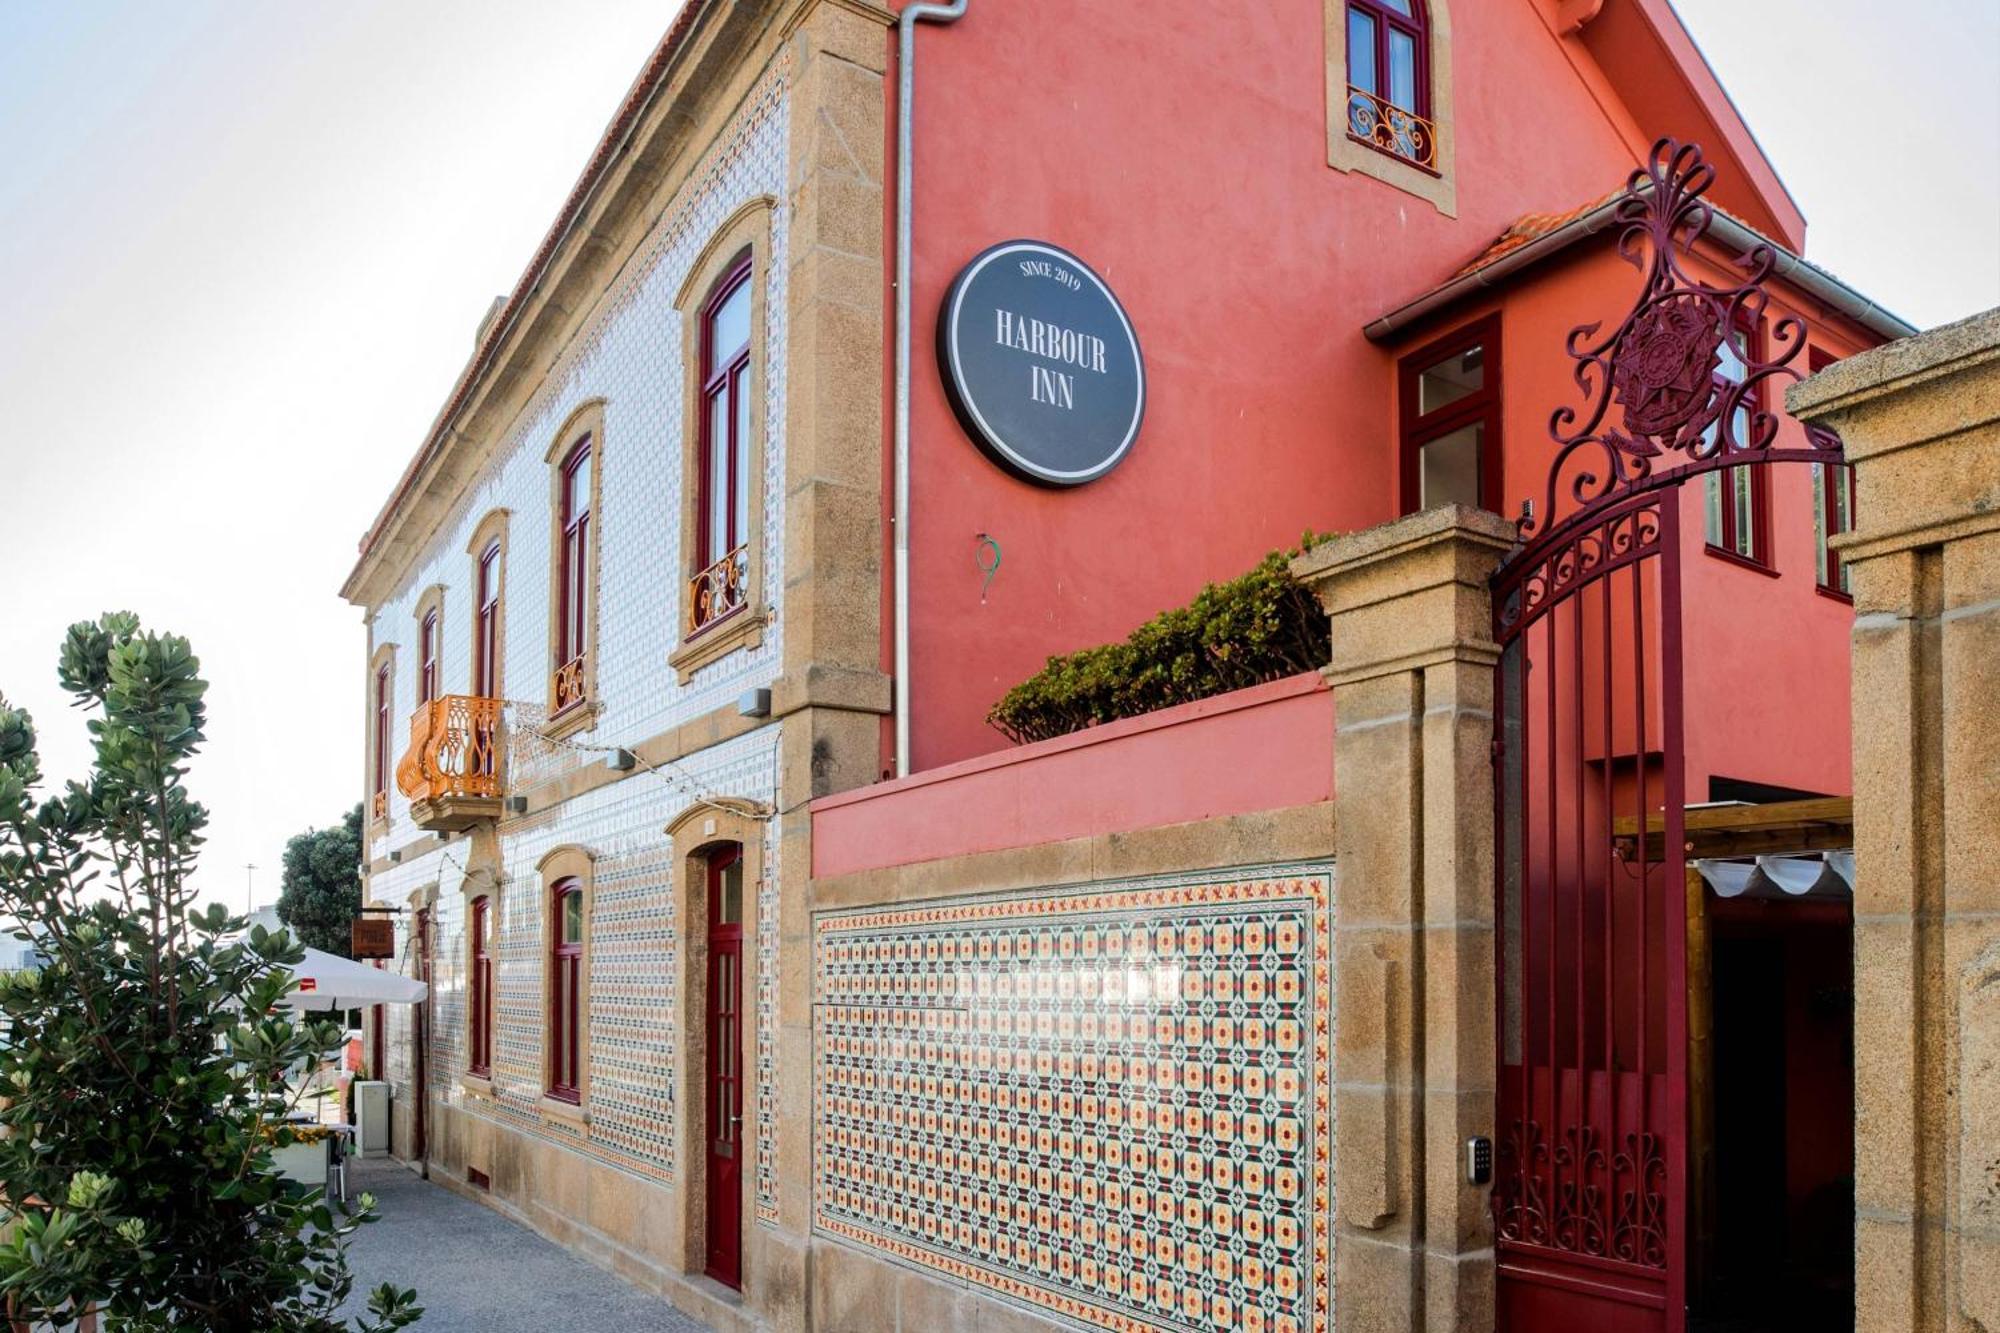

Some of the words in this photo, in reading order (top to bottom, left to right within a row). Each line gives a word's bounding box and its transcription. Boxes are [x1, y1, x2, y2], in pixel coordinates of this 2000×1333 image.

[1020, 261, 1052, 278] SINCE
[1055, 266, 1081, 290] 2019
[995, 309, 1107, 373] HARBOUR
[1030, 366, 1073, 410] INN
